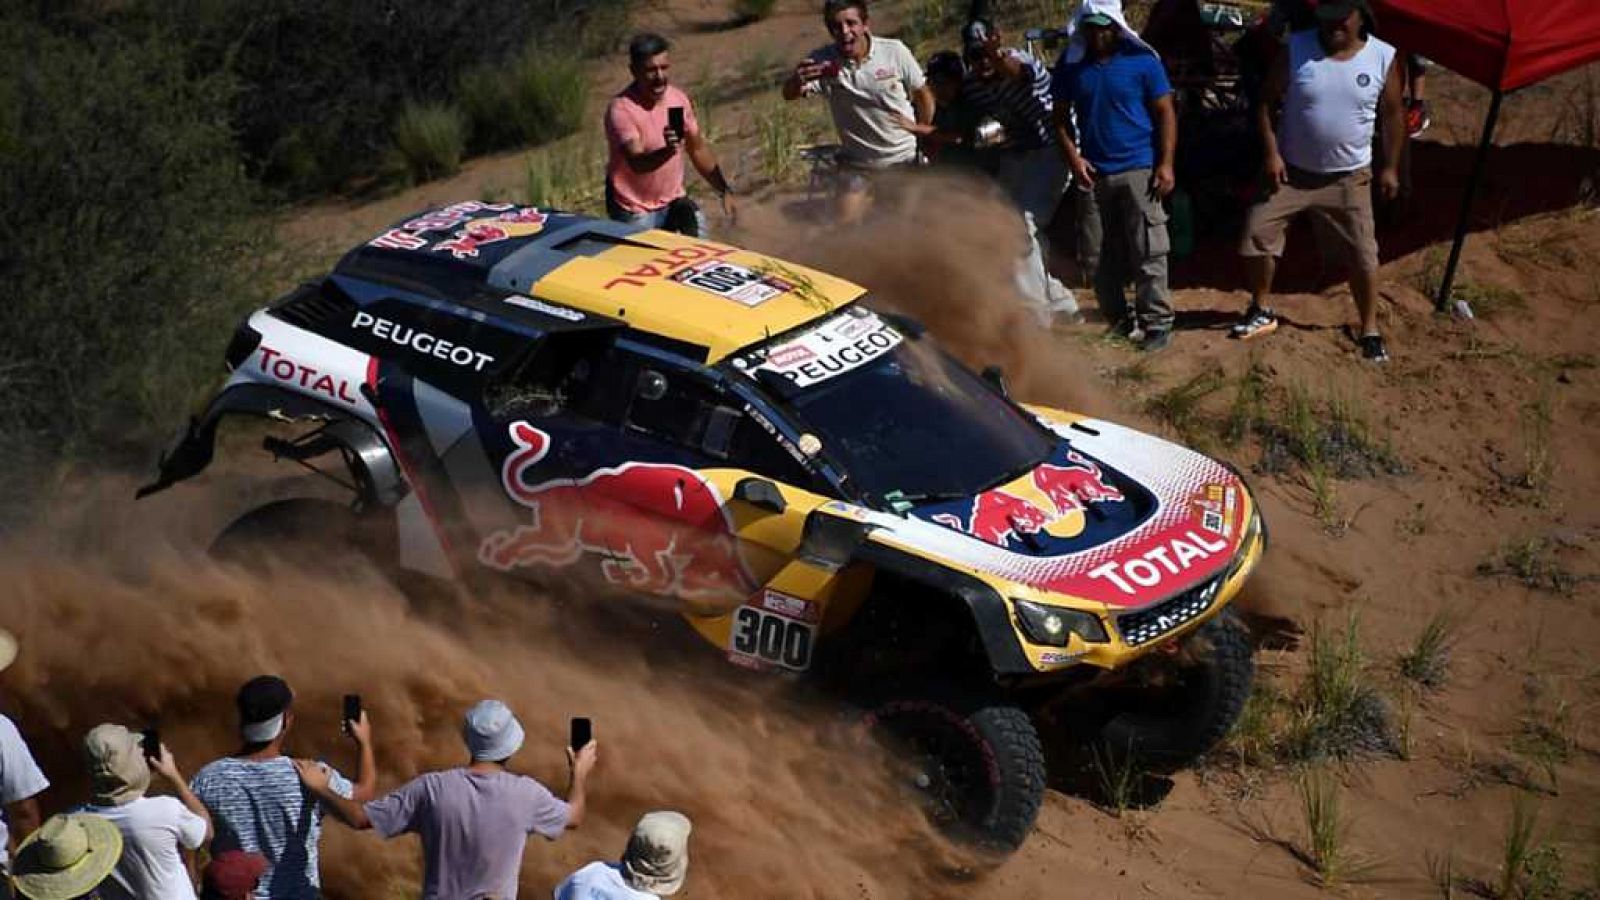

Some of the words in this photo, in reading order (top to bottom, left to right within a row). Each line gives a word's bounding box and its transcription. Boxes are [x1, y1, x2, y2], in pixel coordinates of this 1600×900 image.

[604, 243, 742, 290] TOTAL
[352, 311, 495, 373] PEUGEOT
[260, 346, 357, 404] TOTAL
[1088, 531, 1228, 594] TOTAL
[735, 607, 812, 668] 300
